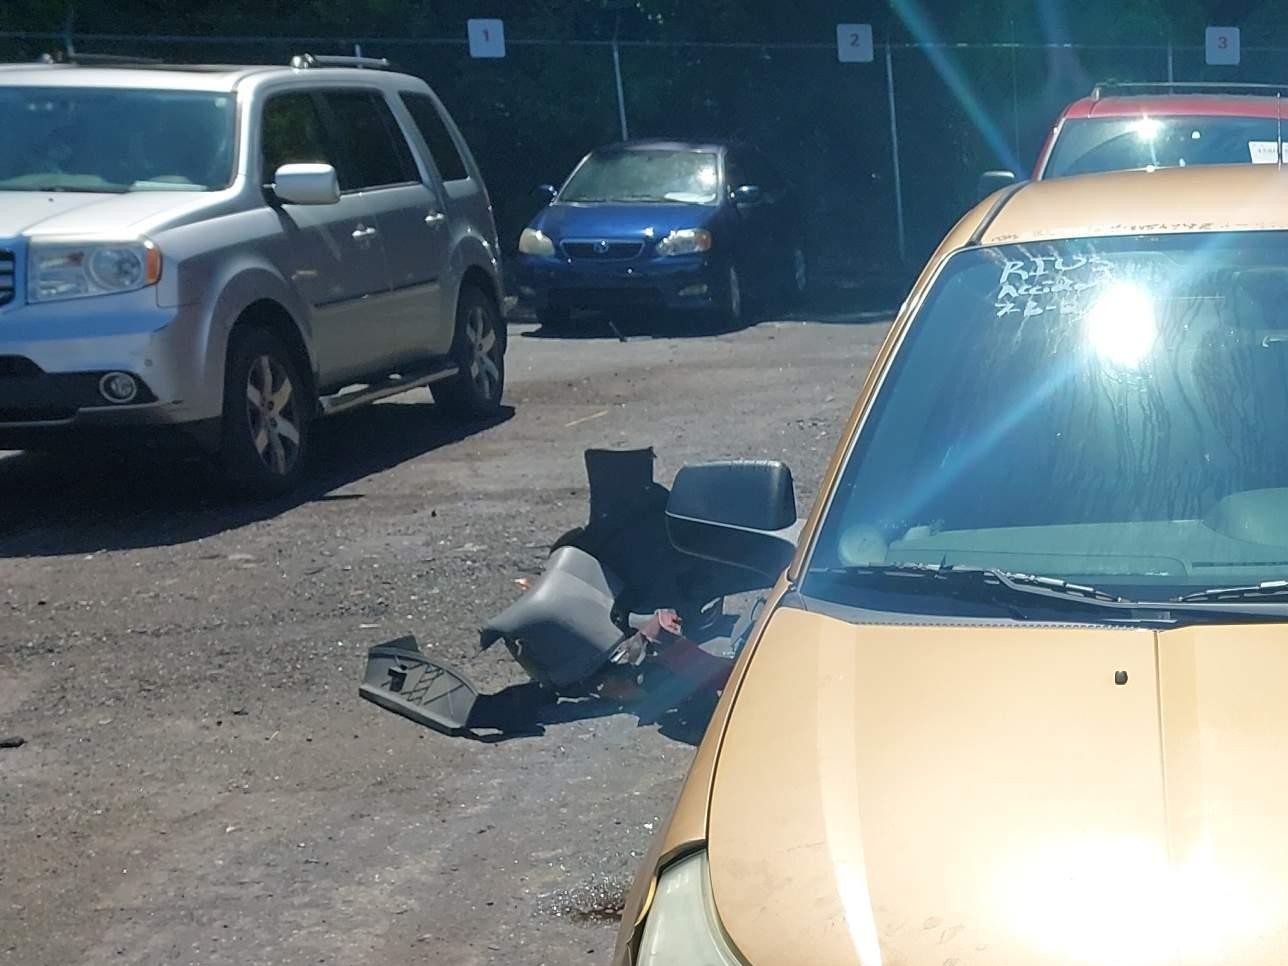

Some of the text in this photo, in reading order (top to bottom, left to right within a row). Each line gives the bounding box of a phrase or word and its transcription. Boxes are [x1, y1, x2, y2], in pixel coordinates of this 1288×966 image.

[481, 29, 490, 42] 1
[849, 33, 862, 47] 2
[1217, 36, 1229, 49] 3
